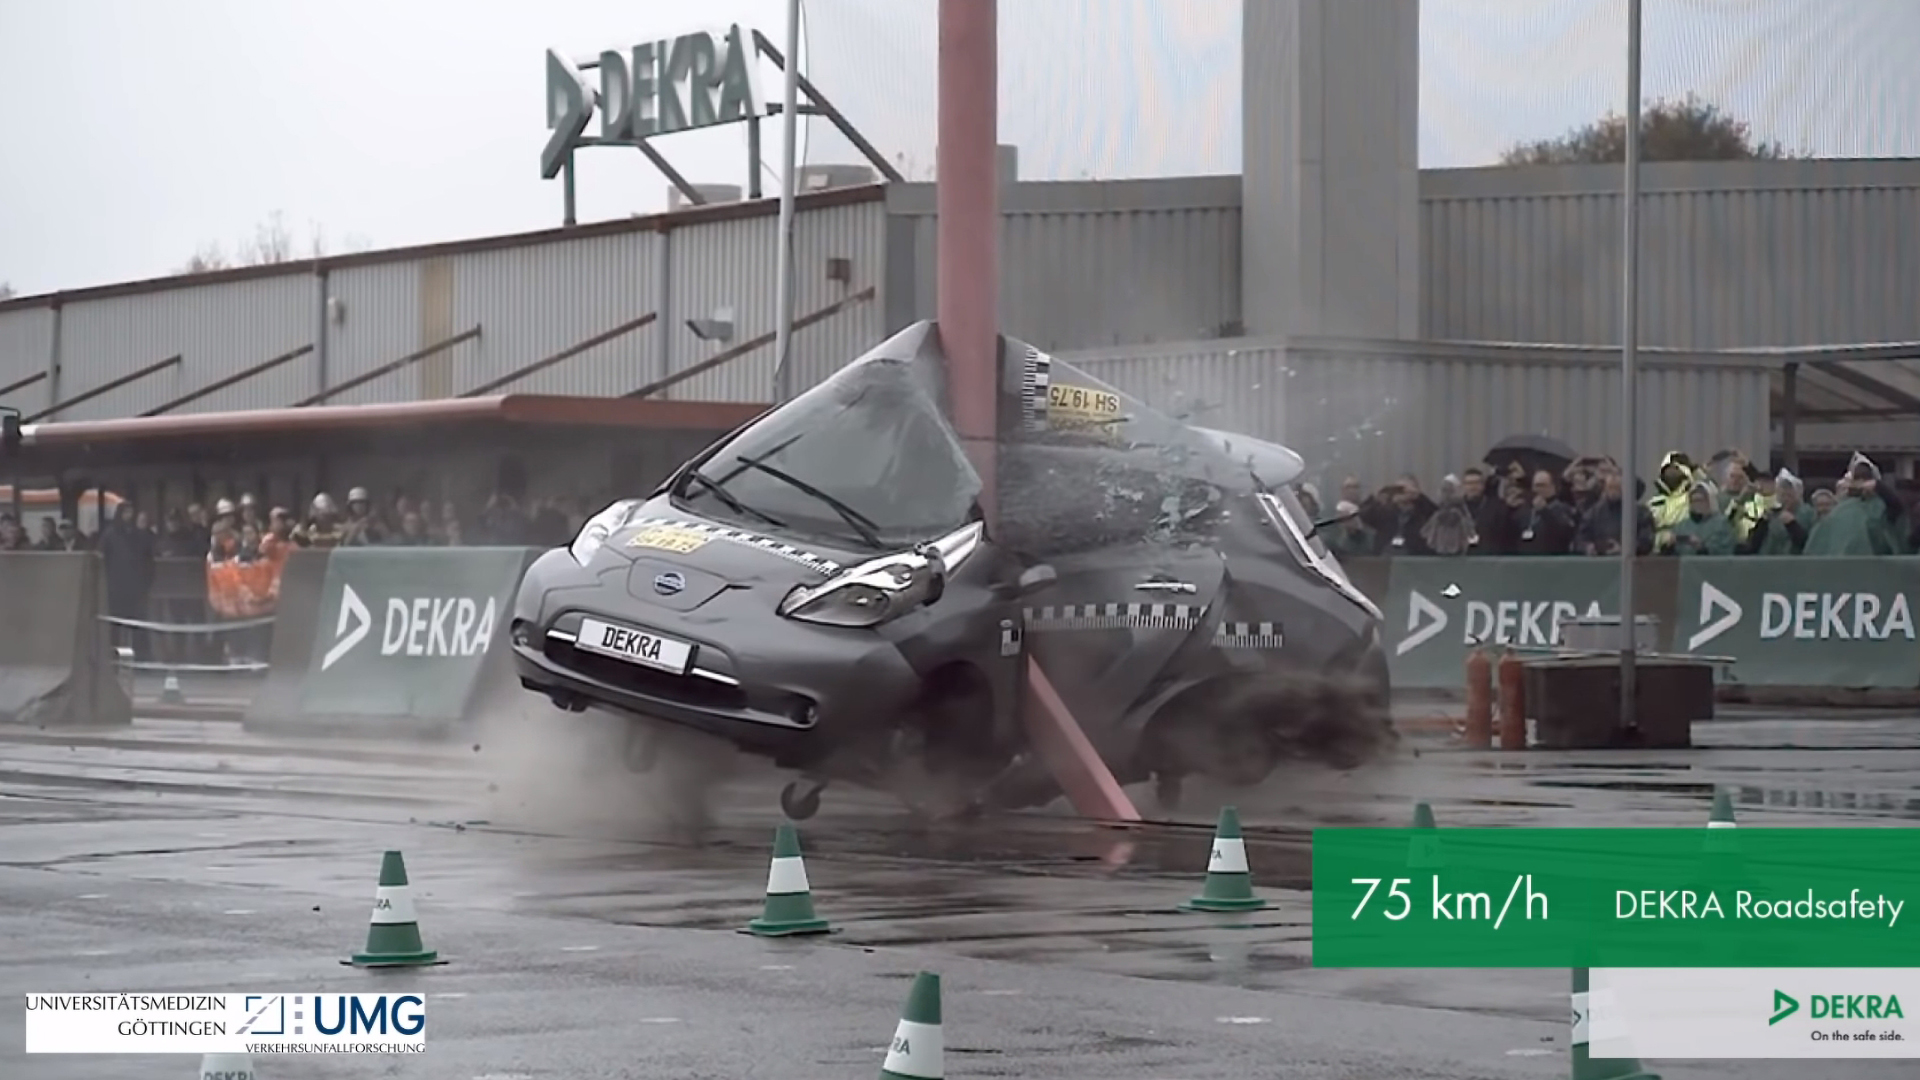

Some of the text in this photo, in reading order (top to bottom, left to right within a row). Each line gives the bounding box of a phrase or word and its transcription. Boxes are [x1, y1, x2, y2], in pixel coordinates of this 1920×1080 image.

[600, 23, 762, 141] DEKRA
[1050, 386, 1118, 413] SH 19.75
[381, 596, 496, 656] DEKRA
[1760, 591, 1916, 640] DEKRA
[601, 626, 662, 660] DEKRA
